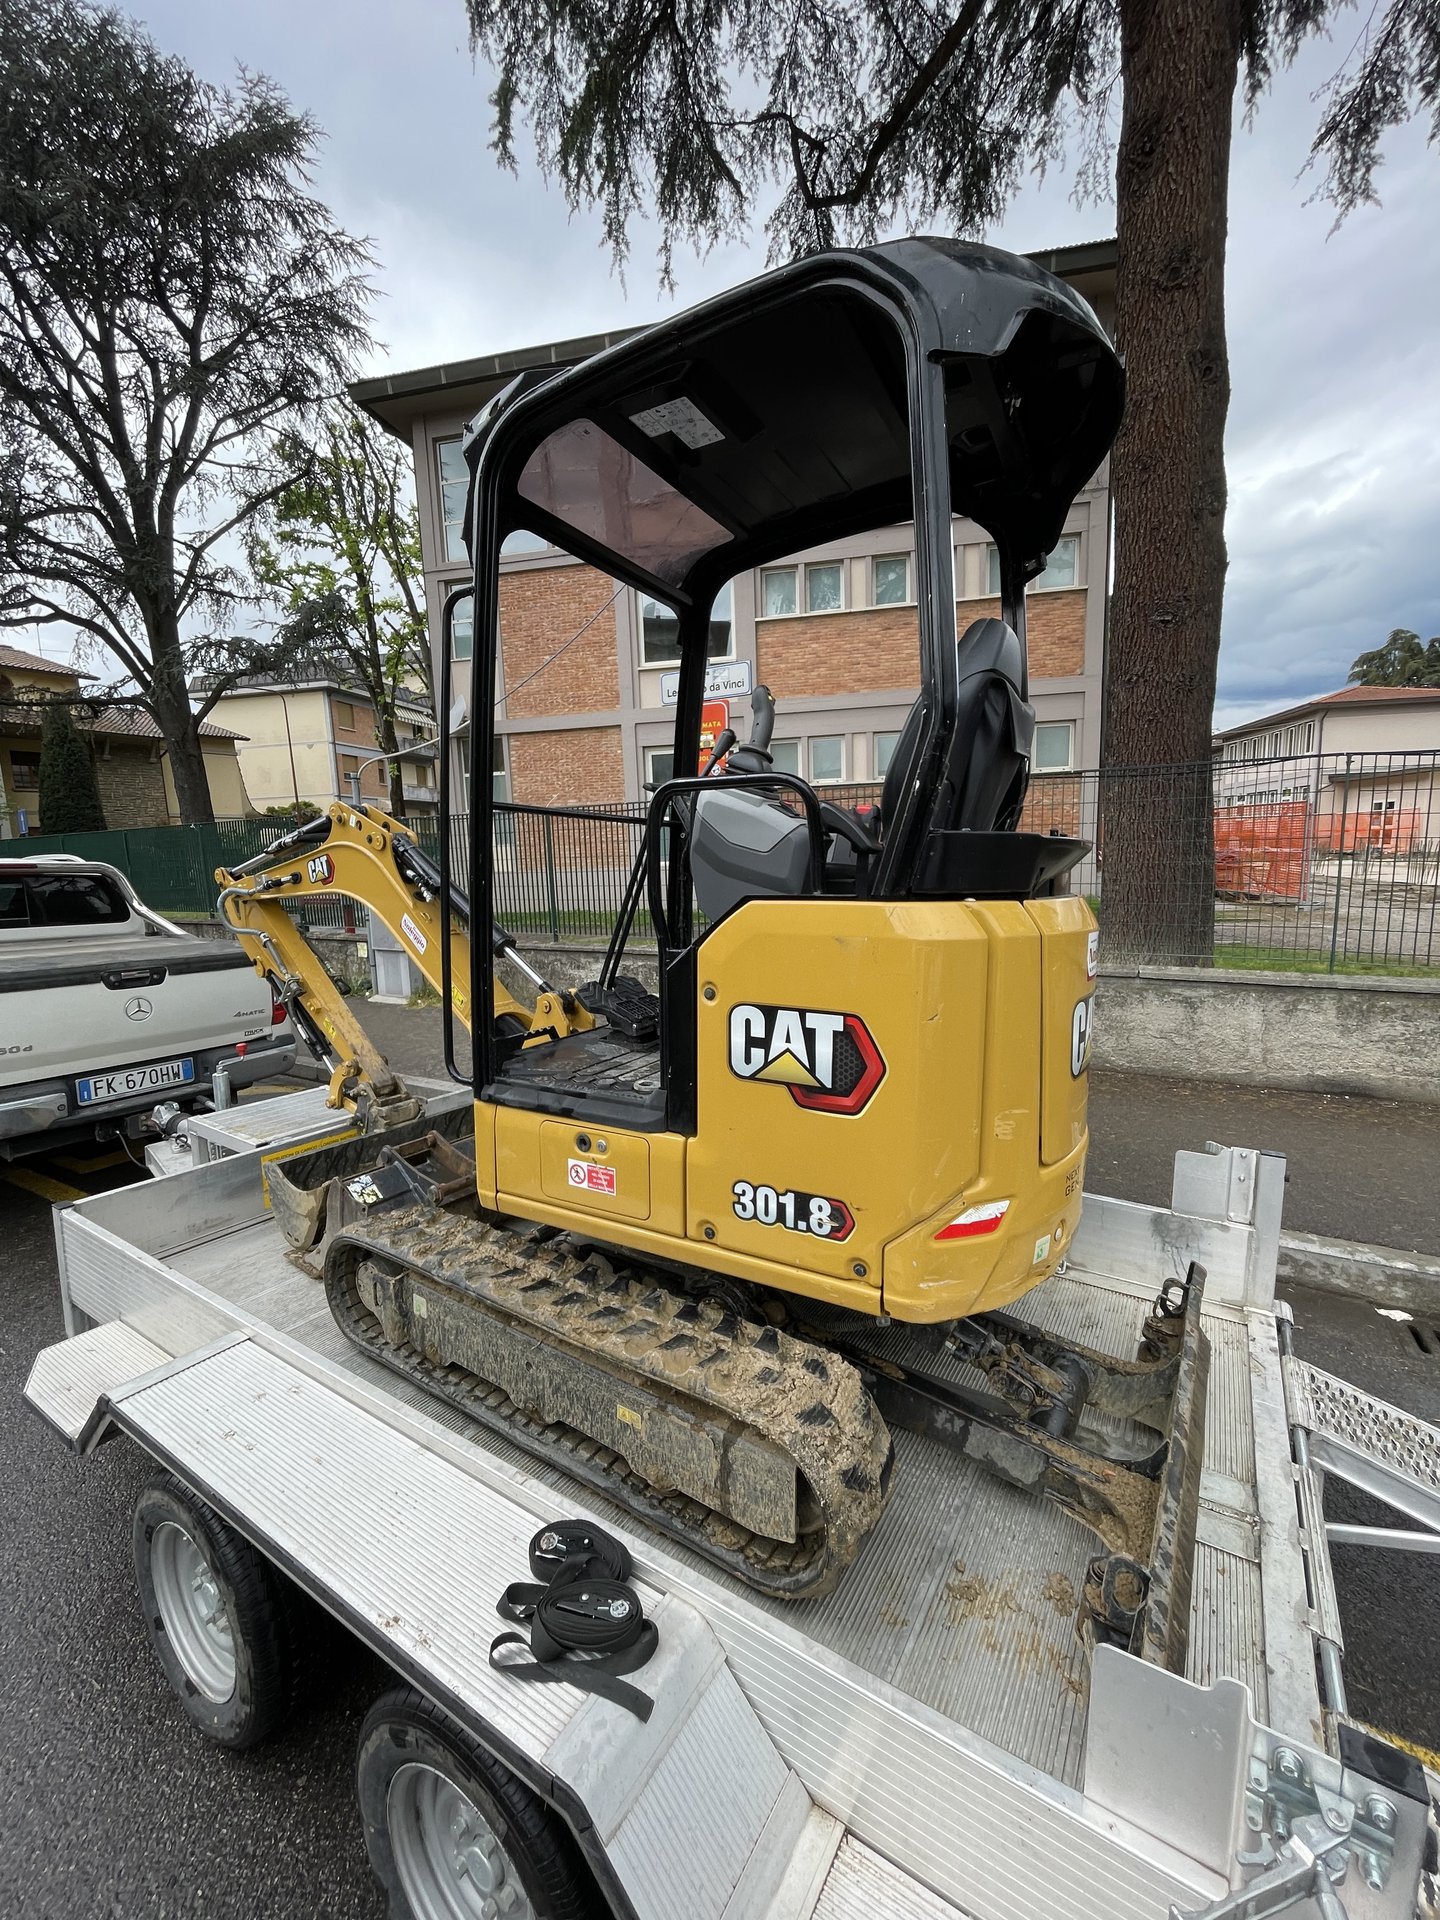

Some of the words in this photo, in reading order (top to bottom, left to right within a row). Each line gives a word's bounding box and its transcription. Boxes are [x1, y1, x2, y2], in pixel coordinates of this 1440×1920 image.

[709, 684, 721, 692] da
[723, 679, 745, 690] Vinci
[307, 855, 329, 883] CAT
[233, 1008, 266, 1018] 4MATIC
[730, 1004, 844, 1089] CAT
[93, 1076, 118, 1098] FK
[125, 1064, 181, 1090] 670HW
[1065, 1164, 1081, 1184] NEXT
[733, 1180, 833, 1237] 301.8
